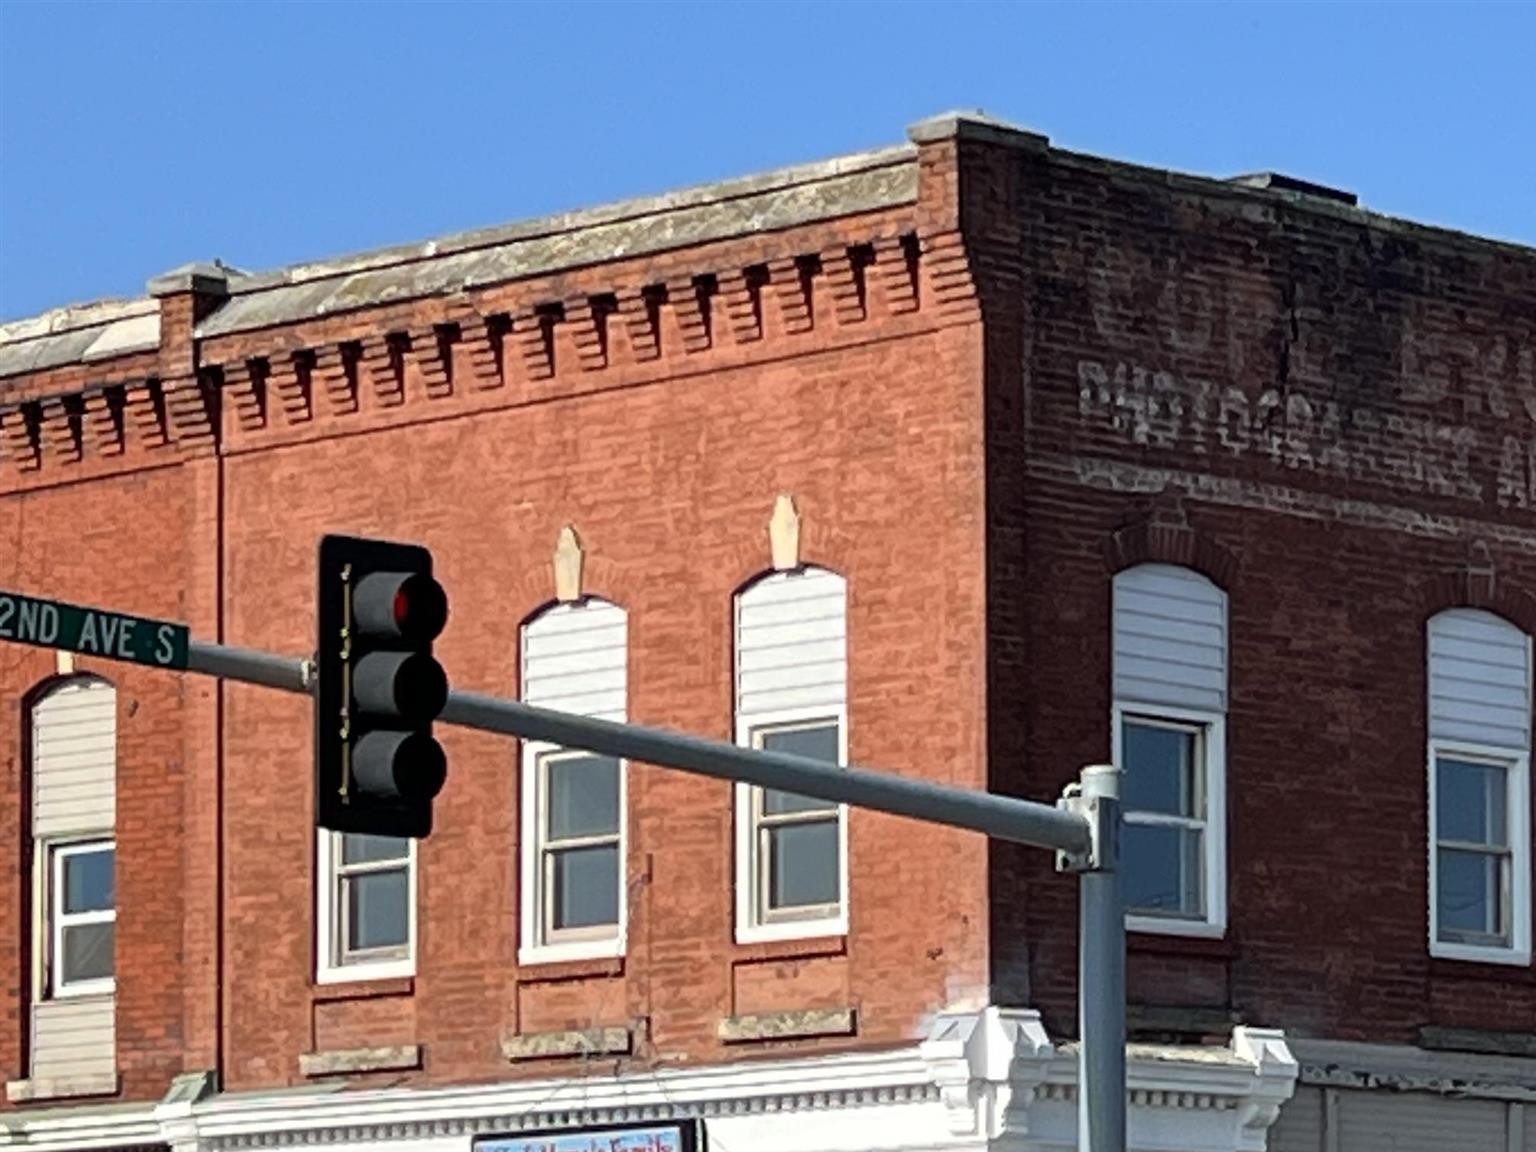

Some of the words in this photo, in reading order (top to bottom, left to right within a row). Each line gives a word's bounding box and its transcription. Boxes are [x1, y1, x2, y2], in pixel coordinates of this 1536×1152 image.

[0, 597, 59, 644] 2ND
[77, 612, 137, 658] AVE
[155, 625, 175, 664] S
